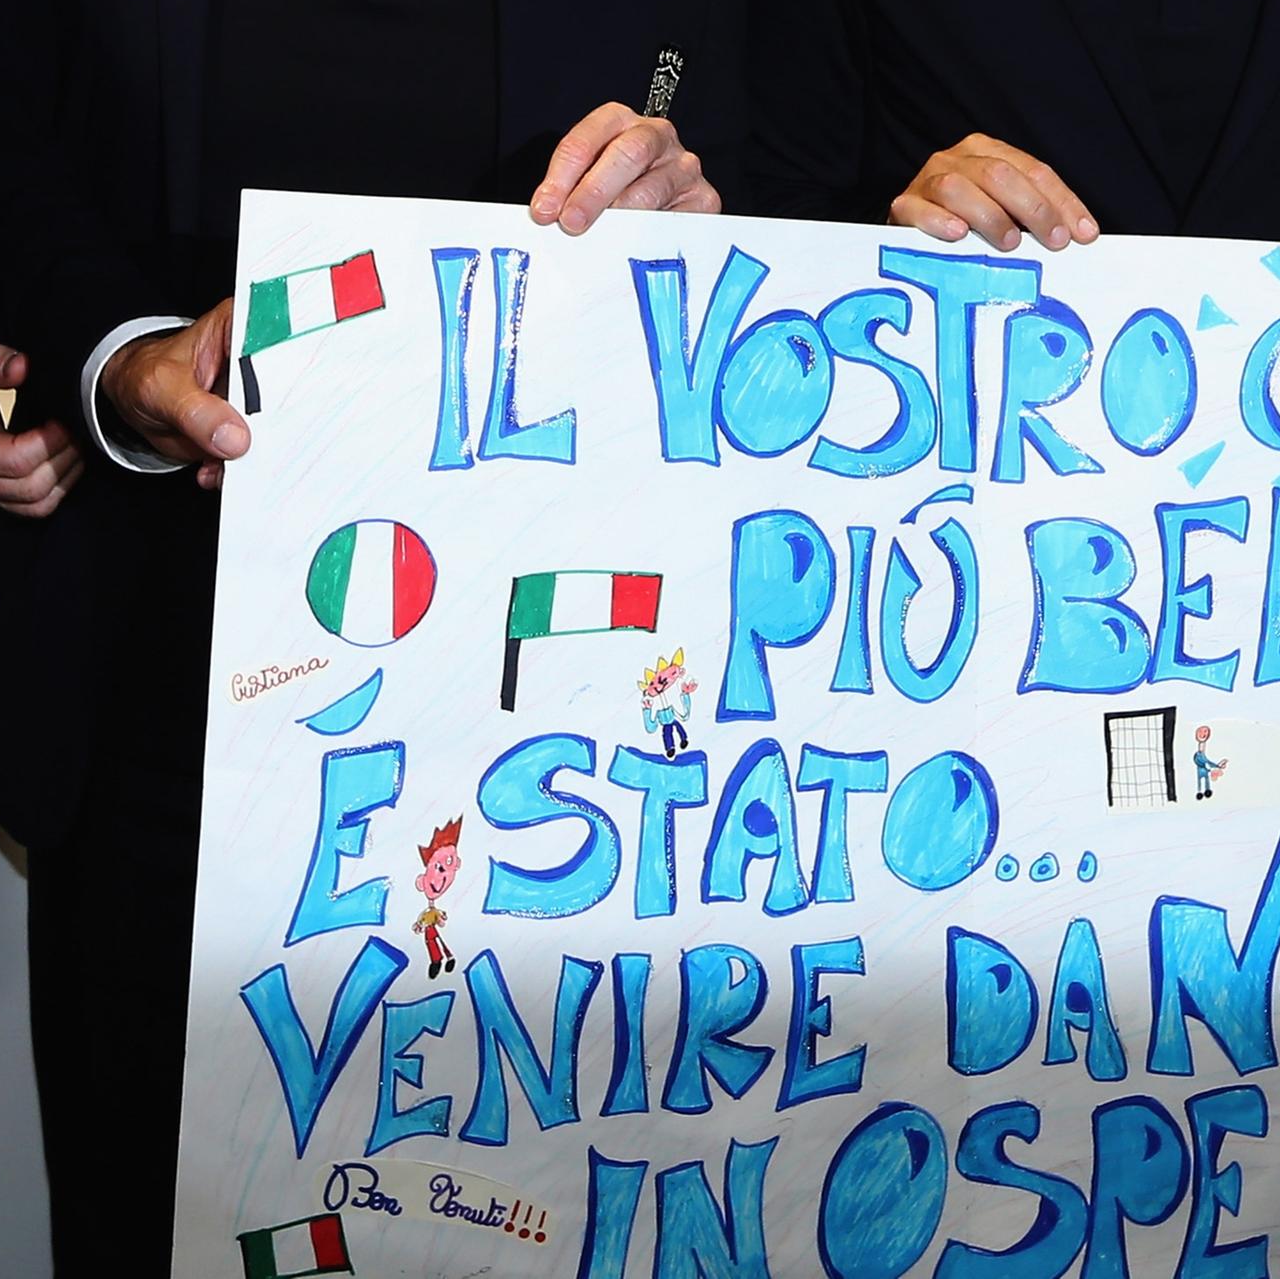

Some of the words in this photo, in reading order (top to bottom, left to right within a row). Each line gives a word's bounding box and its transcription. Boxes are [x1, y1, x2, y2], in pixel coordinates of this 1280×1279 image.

[427, 247, 577, 472] IL
[629, 245, 1198, 482] VOSTRO
[239, 935, 868, 1159] VENIRE
[946, 916, 1128, 1082] DA
[323, 1161, 404, 1217] Ben
[575, 1135, 781, 1279] IN
